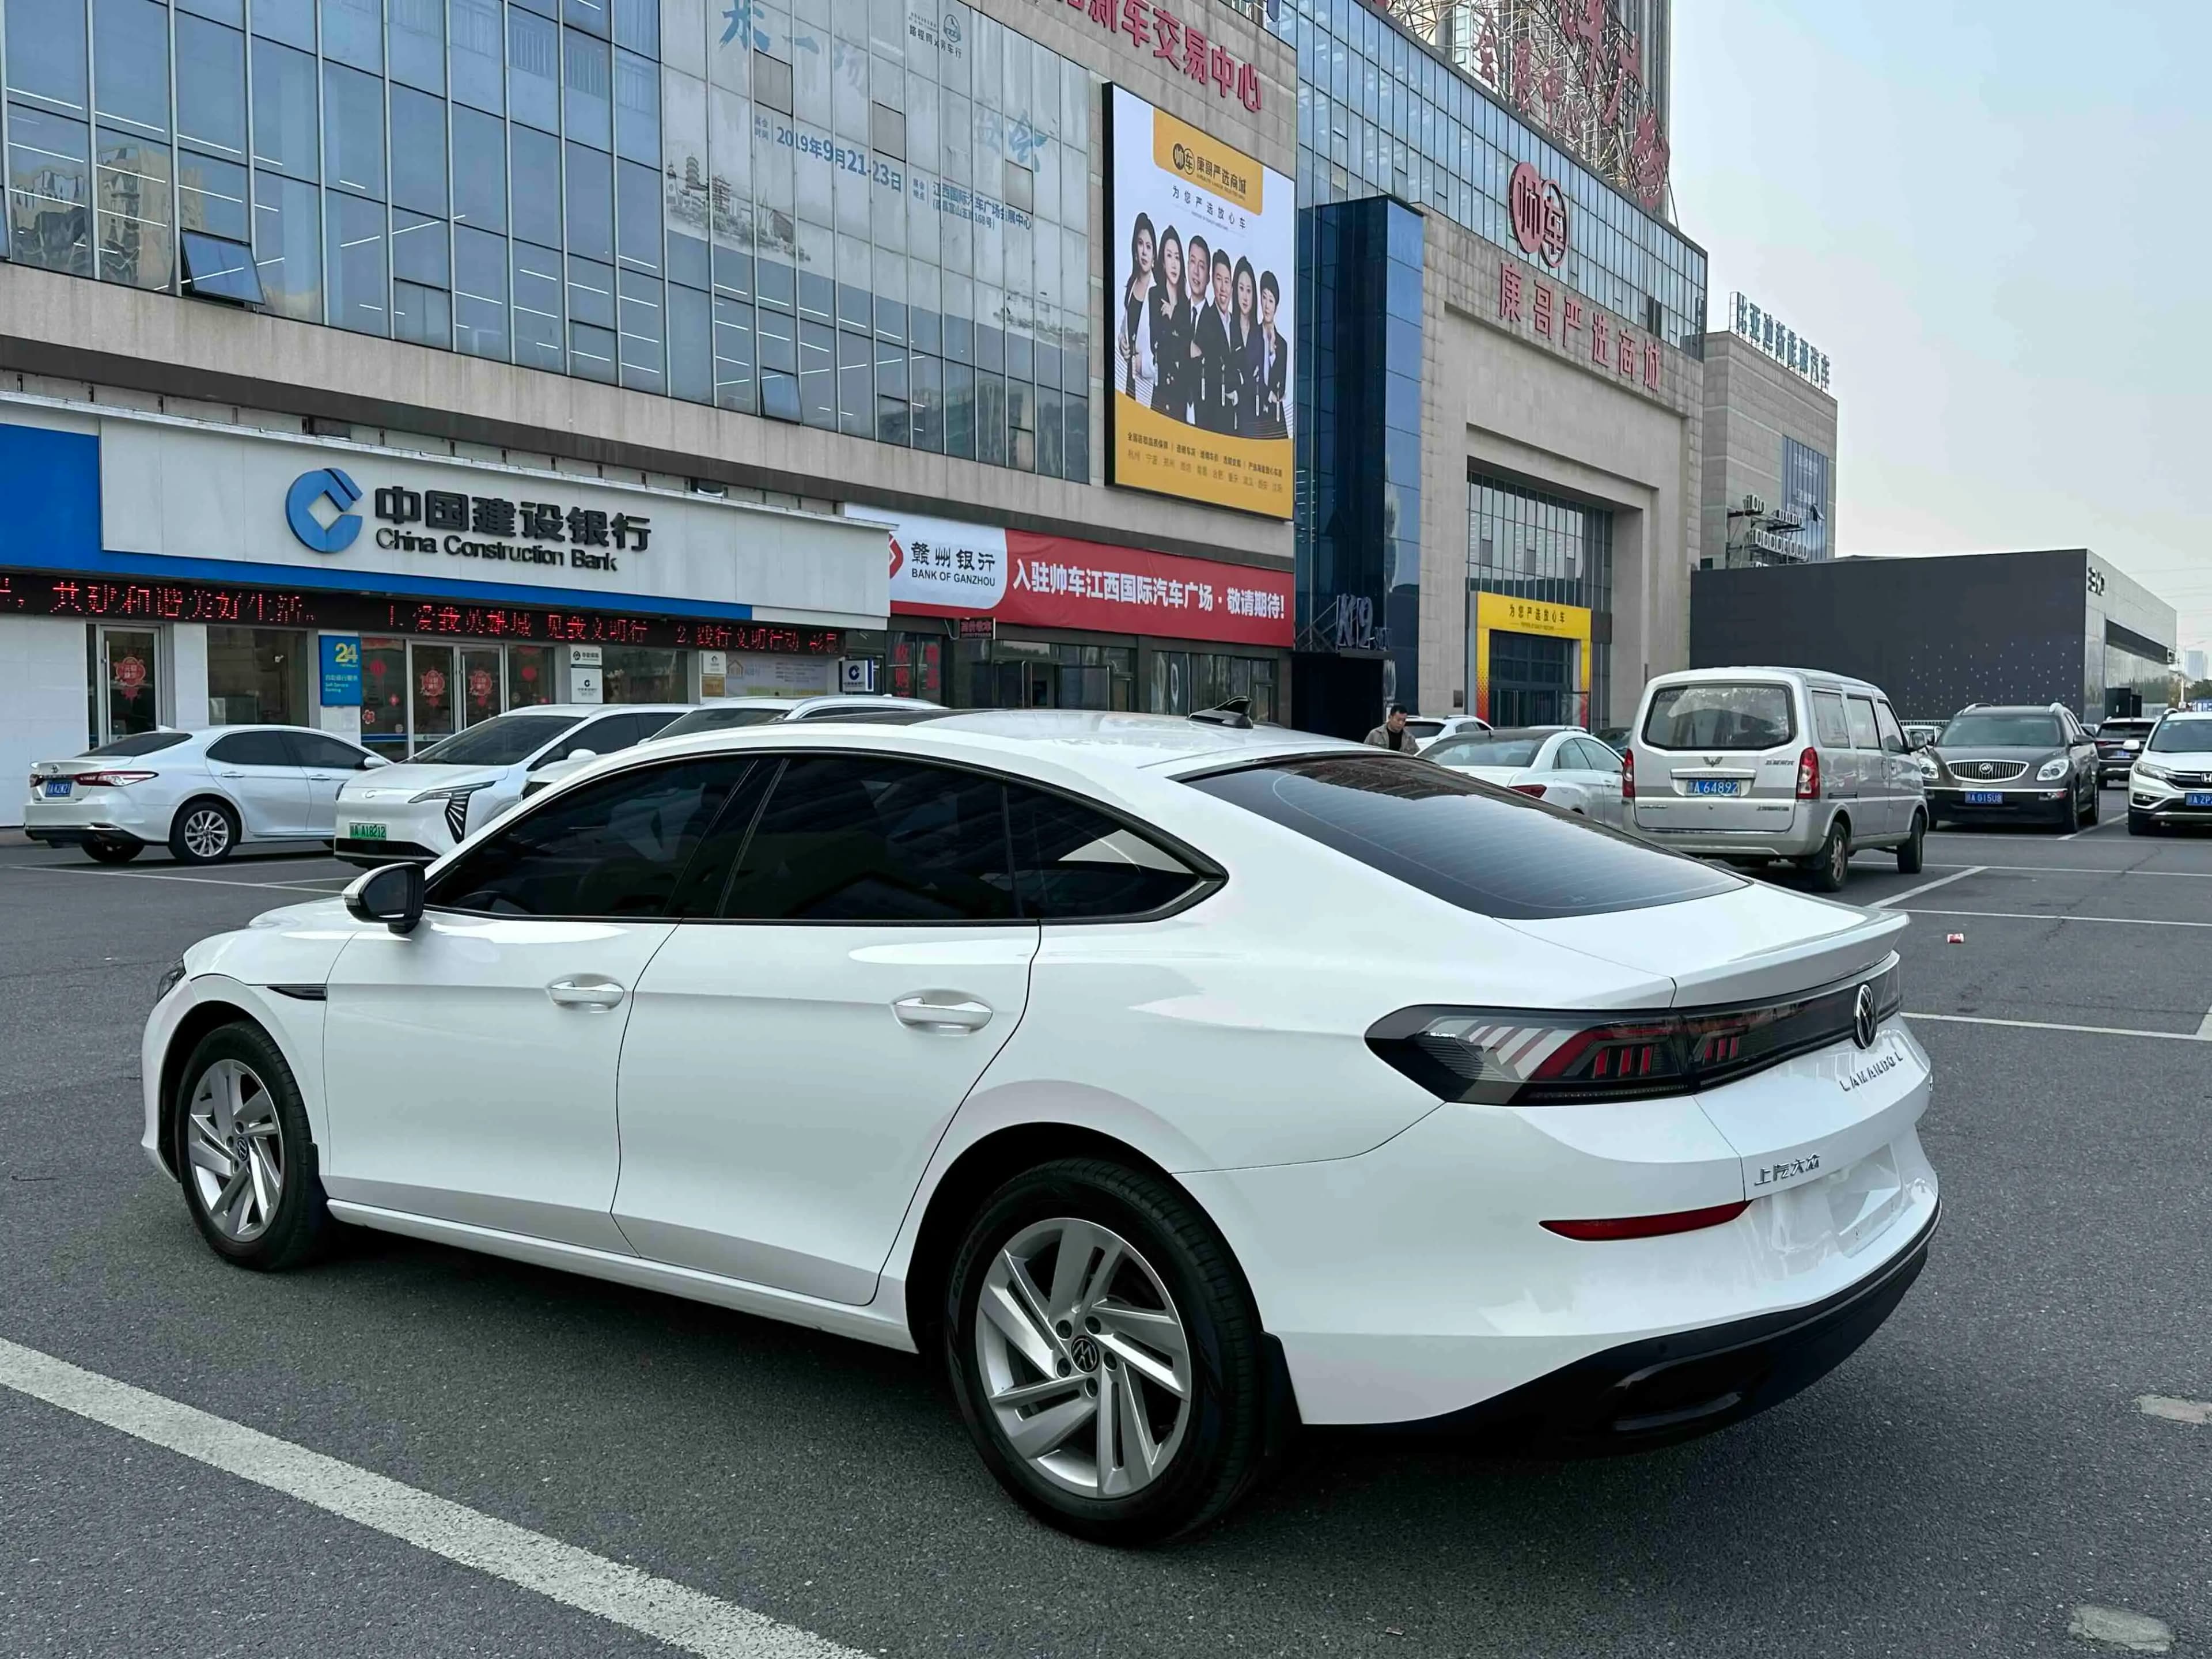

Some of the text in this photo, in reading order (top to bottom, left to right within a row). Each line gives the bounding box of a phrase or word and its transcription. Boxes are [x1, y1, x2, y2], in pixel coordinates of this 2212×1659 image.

[1067, 0, 1262, 112] 新车交易中心
[375, 486, 651, 551] 中国建设银行
[376, 528, 618, 571] China Construction Bank
[911, 541, 995, 572] 赣州银行
[911, 567, 995, 586] BANK OF GANZHOU
[1510, 605, 1566, 623] 为您严选放心车
[335, 643, 358, 663] 24
[1839, 1055, 1896, 1092] LAMANDO
[1754, 1153, 1820, 1186] 上汽大众
